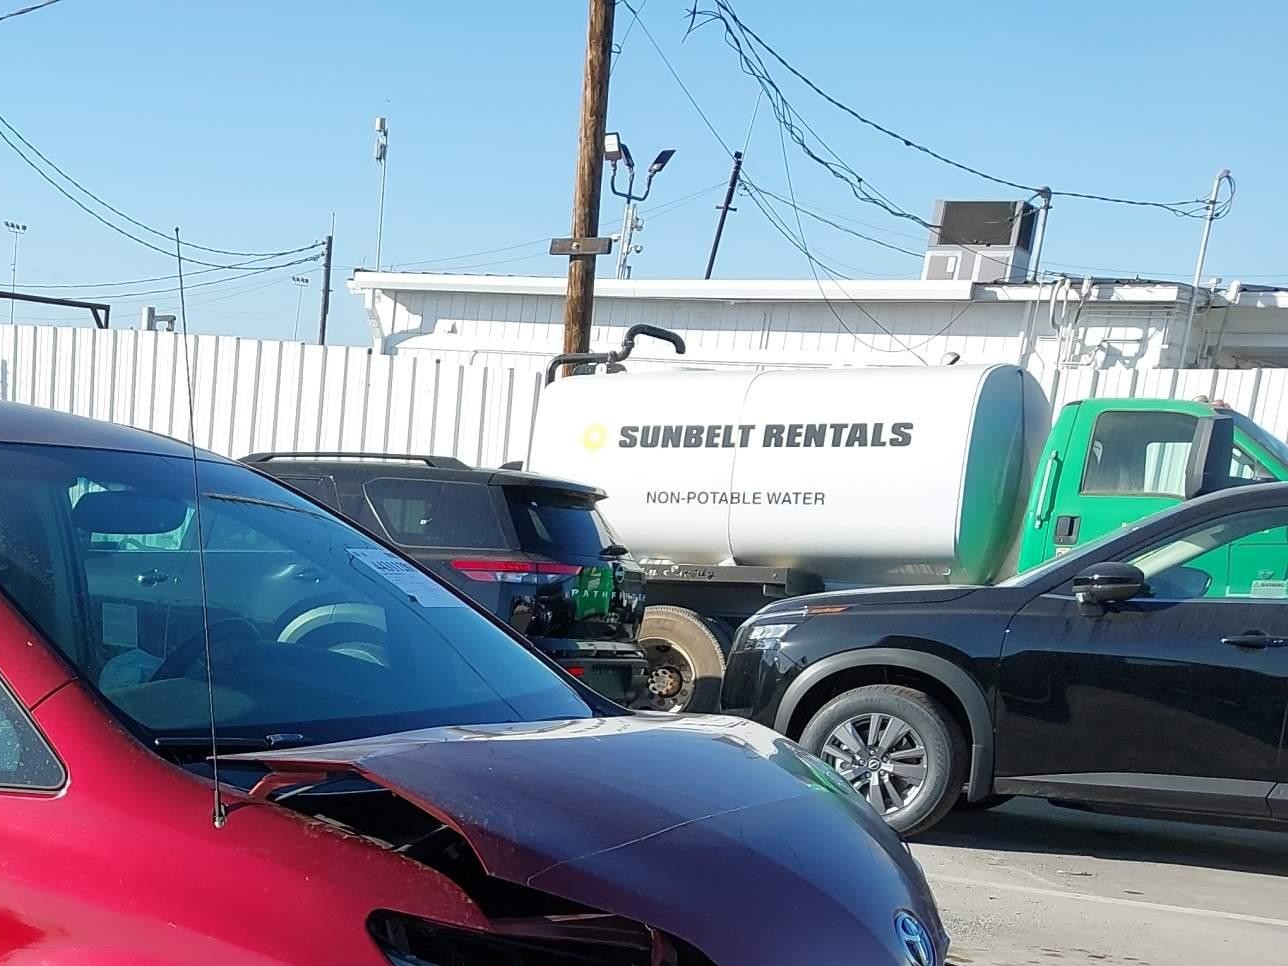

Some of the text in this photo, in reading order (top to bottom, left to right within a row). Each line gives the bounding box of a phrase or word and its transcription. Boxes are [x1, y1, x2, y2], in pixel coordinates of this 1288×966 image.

[619, 423, 914, 448] SUNBELT RENTALS
[646, 491, 826, 505] NON-POTABLE WATER
